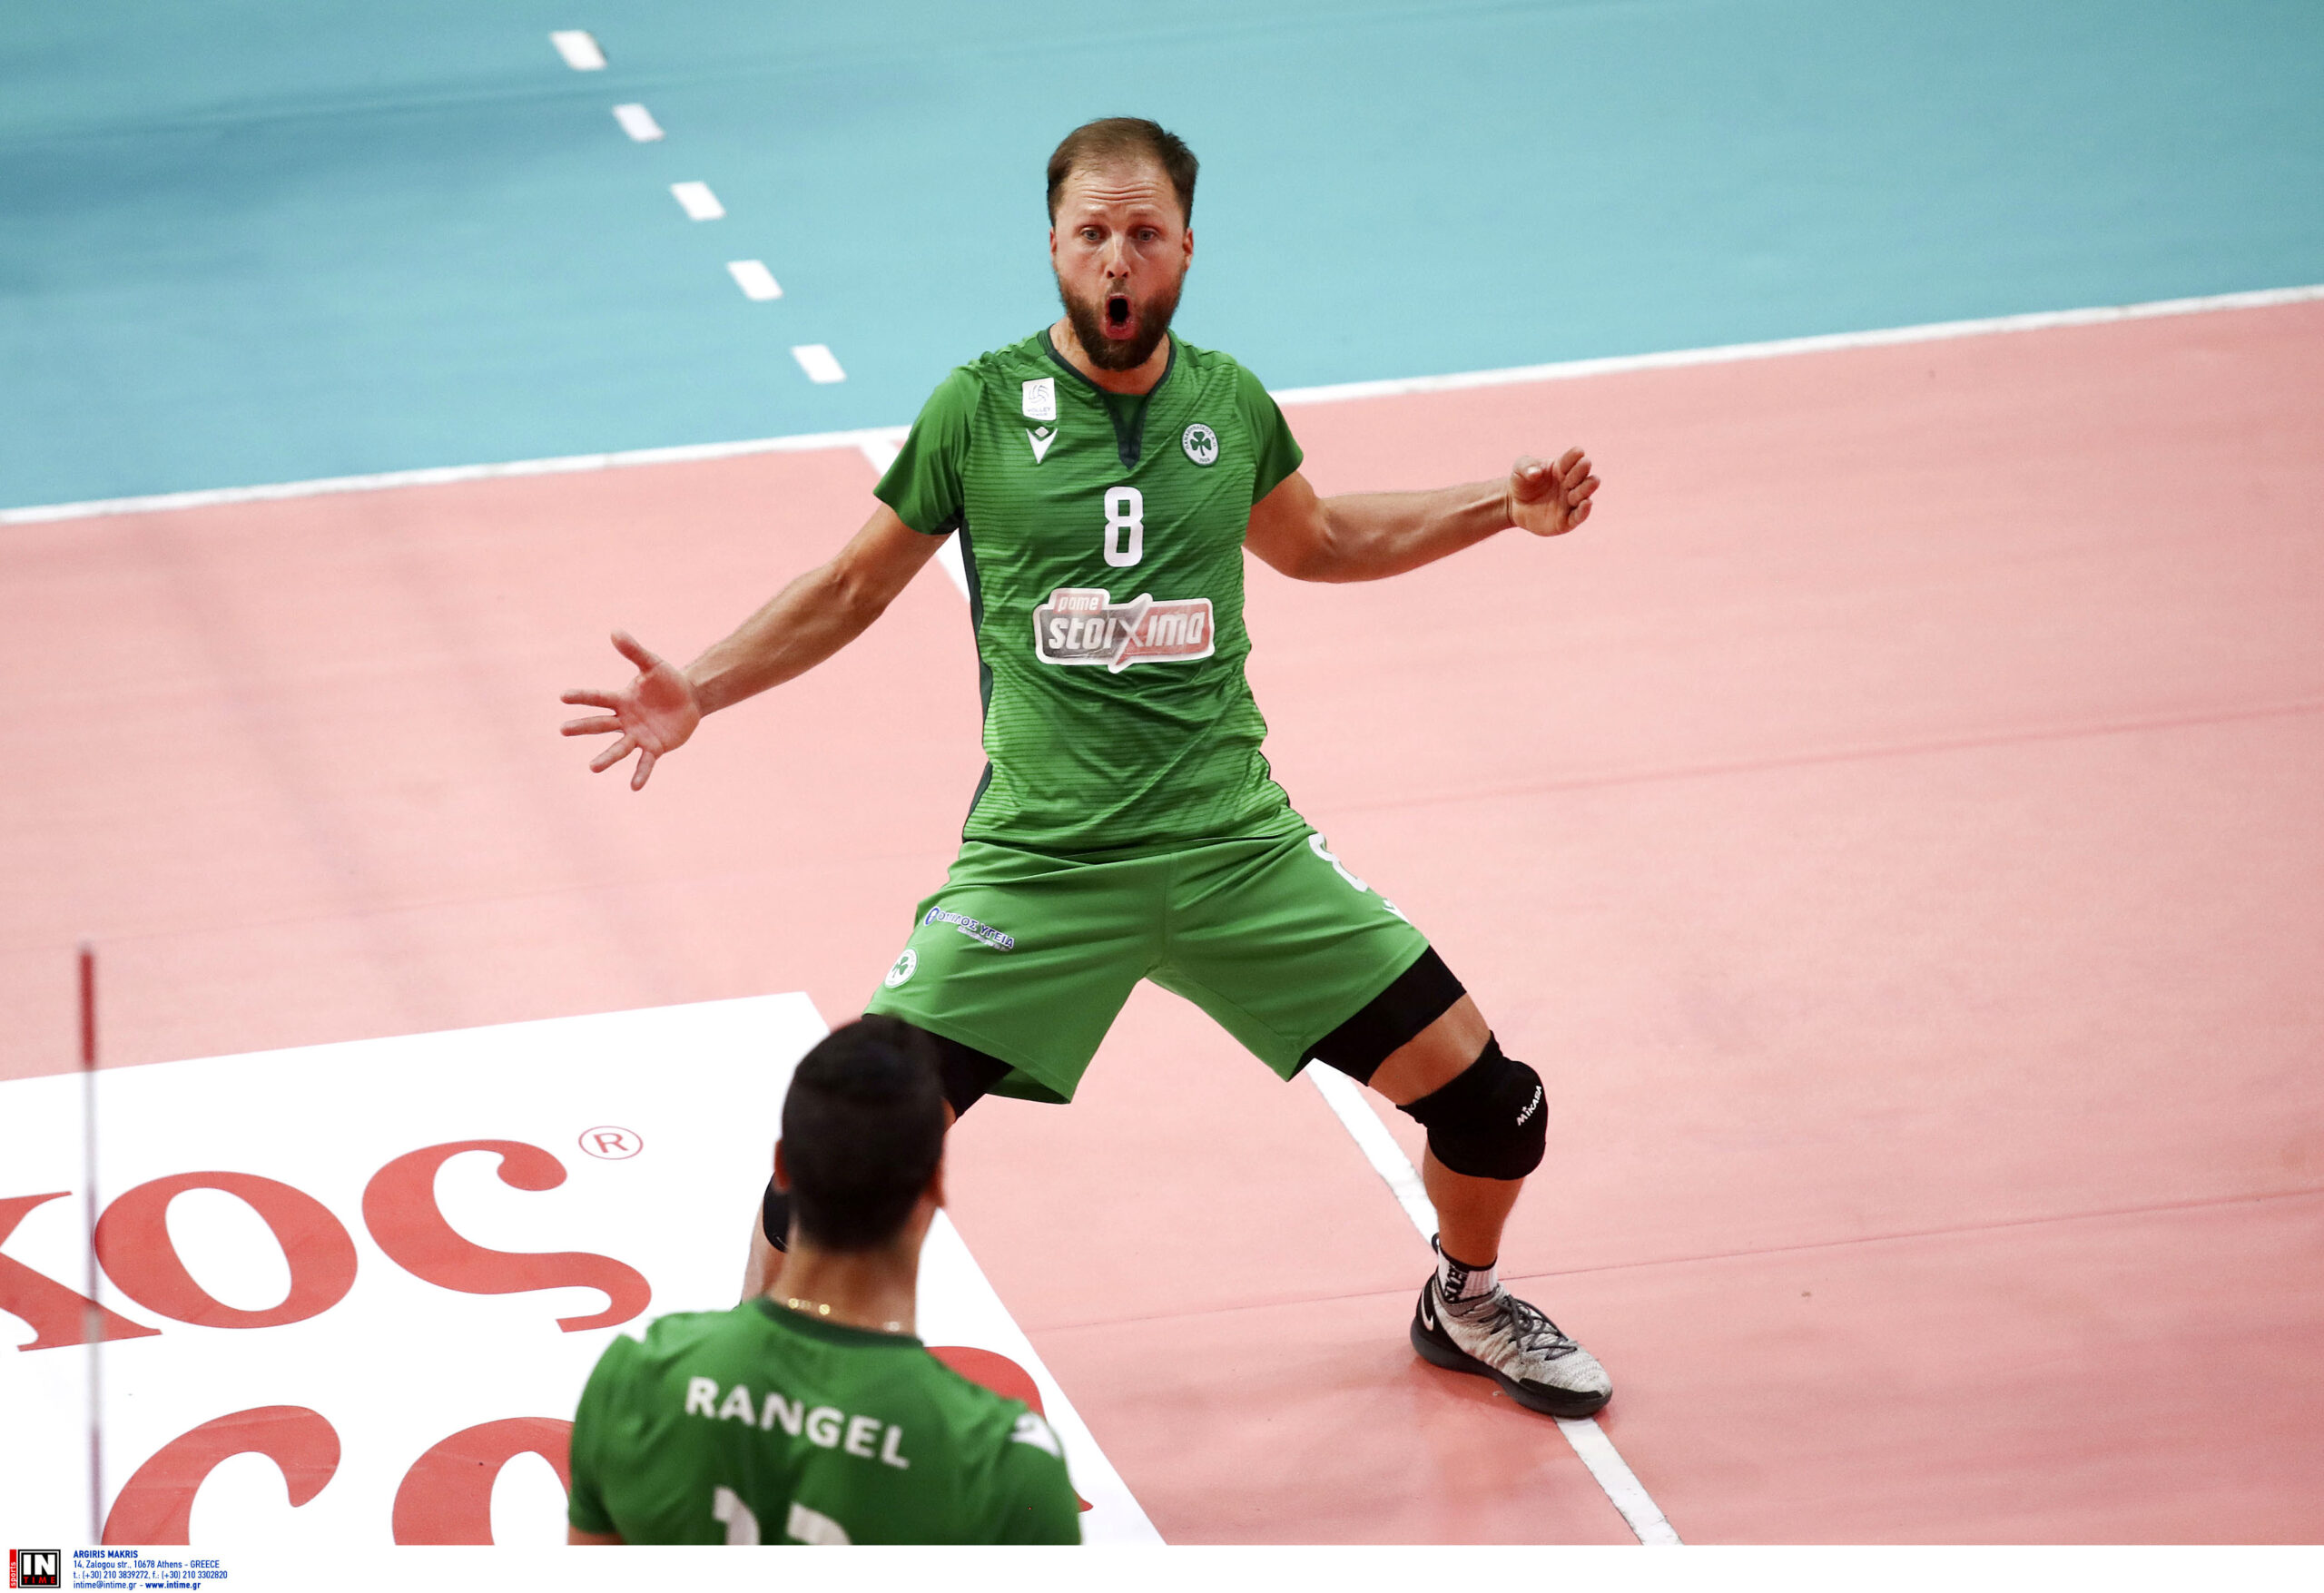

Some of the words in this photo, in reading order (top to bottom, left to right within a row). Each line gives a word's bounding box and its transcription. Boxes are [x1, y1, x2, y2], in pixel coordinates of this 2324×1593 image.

[1104, 486, 1144, 567] 8
[1058, 595, 1098, 613] pame
[980, 924, 1014, 948] ΥΓΕΙΑ
[685, 1375, 910, 1470] RANGEL
